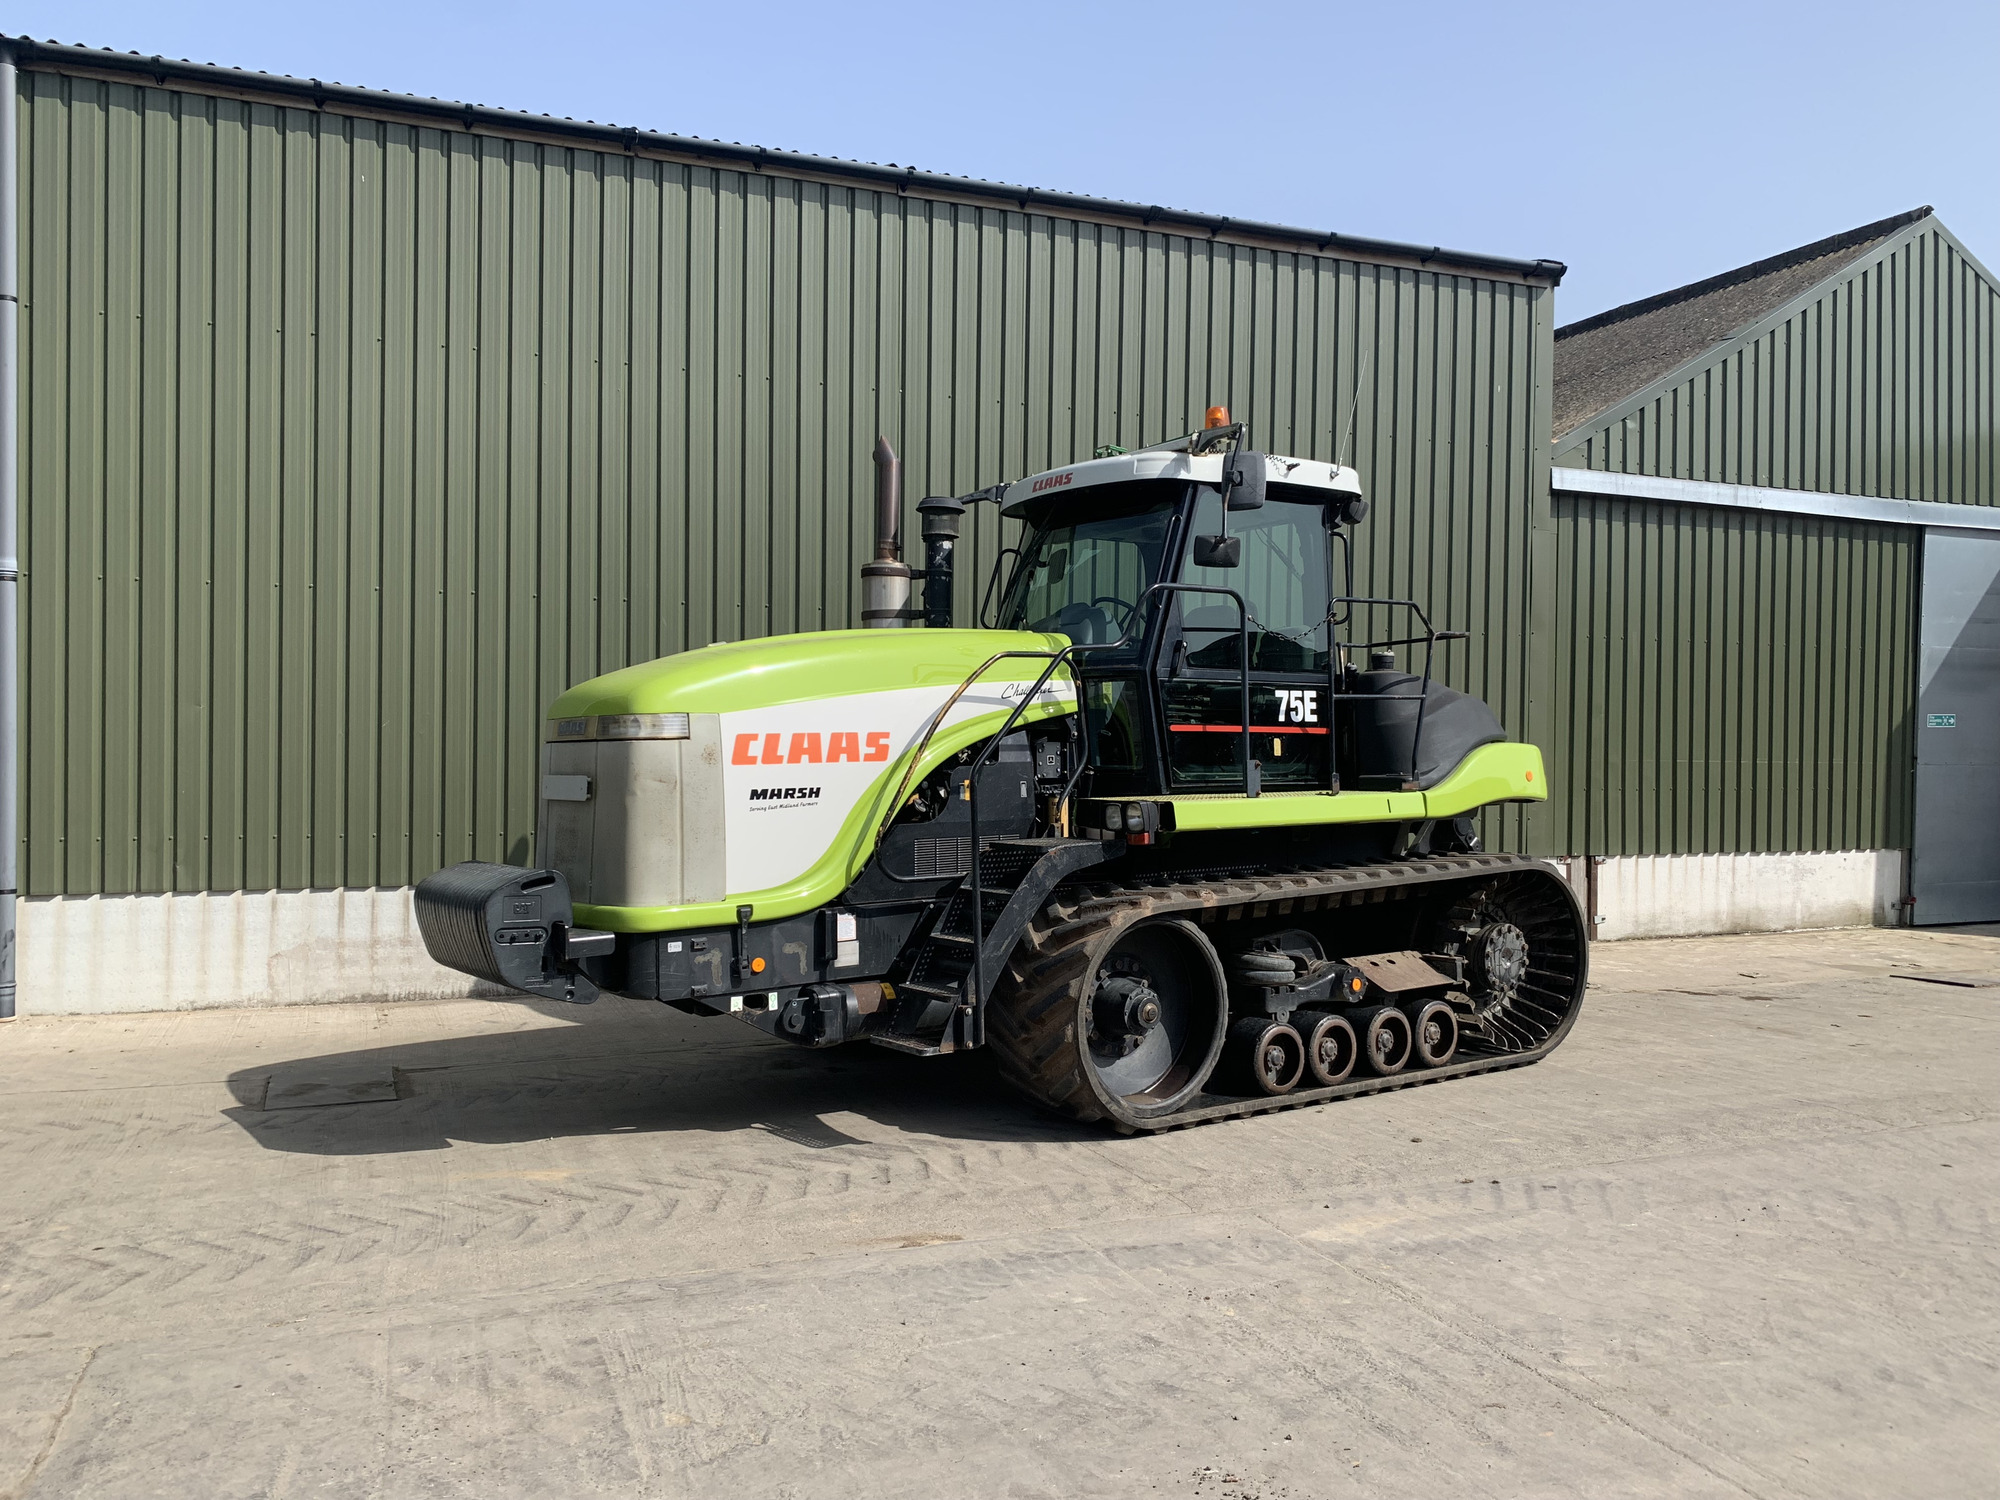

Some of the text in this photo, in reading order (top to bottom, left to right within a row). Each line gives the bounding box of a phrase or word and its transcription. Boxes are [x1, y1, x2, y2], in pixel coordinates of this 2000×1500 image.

[1032, 472, 1073, 493] CLAAS
[1001, 683, 1066, 701] Challger
[1274, 690, 1318, 723] 75E
[731, 731, 891, 766] CLAAS
[749, 787, 821, 800] MARSH
